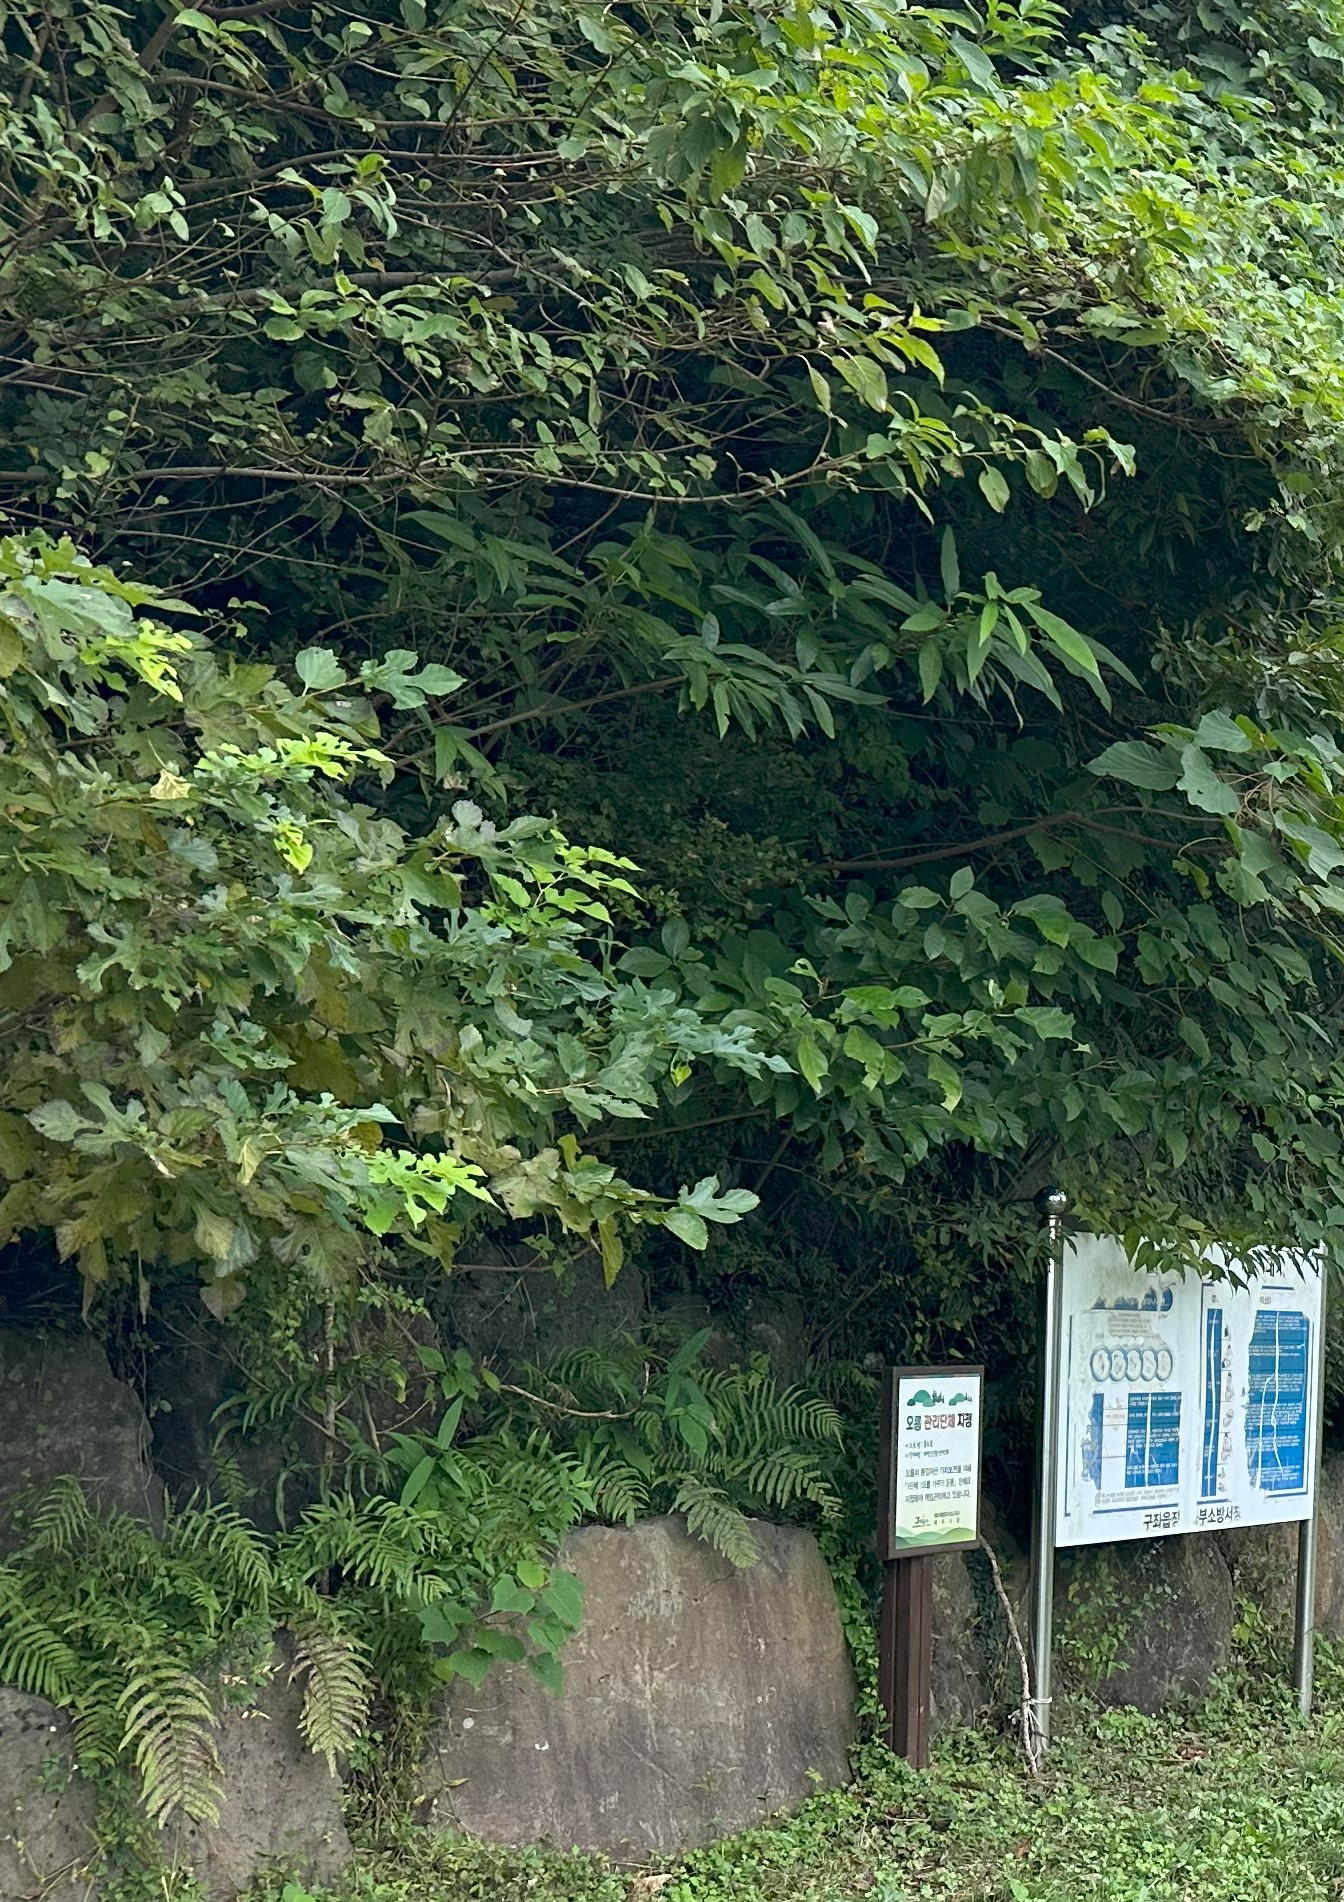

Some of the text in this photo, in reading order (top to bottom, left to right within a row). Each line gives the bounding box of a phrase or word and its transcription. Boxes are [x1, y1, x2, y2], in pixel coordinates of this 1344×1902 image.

[905, 1412, 973, 1431] 오름 관리단체 지정
